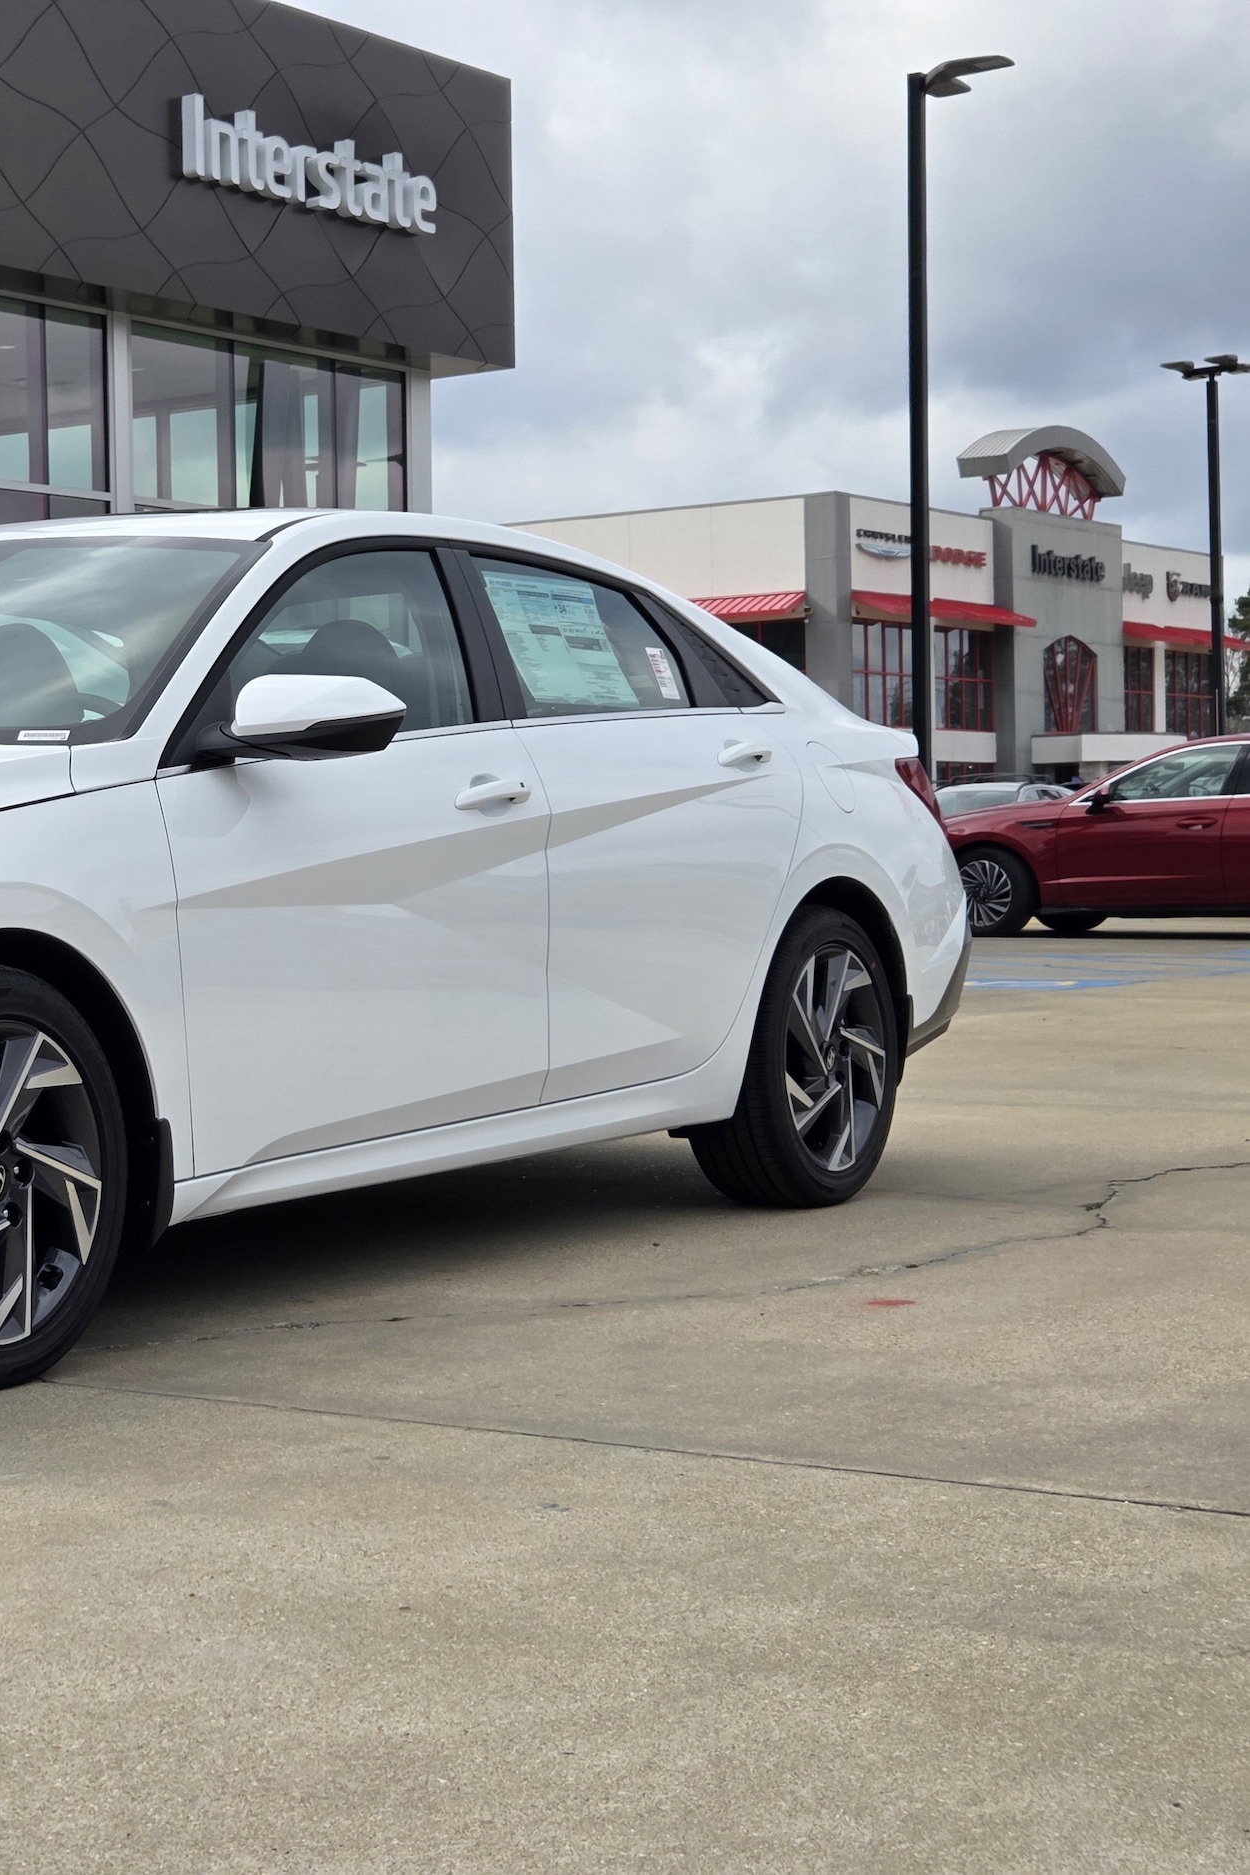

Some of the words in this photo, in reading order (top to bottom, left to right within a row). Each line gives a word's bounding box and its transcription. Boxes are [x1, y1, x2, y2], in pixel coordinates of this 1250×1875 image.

[181, 92, 437, 234] Interstate
[929, 545, 987, 568] DODGE
[1031, 544, 1106, 582] Interstate
[1122, 563, 1153, 600] Jeep
